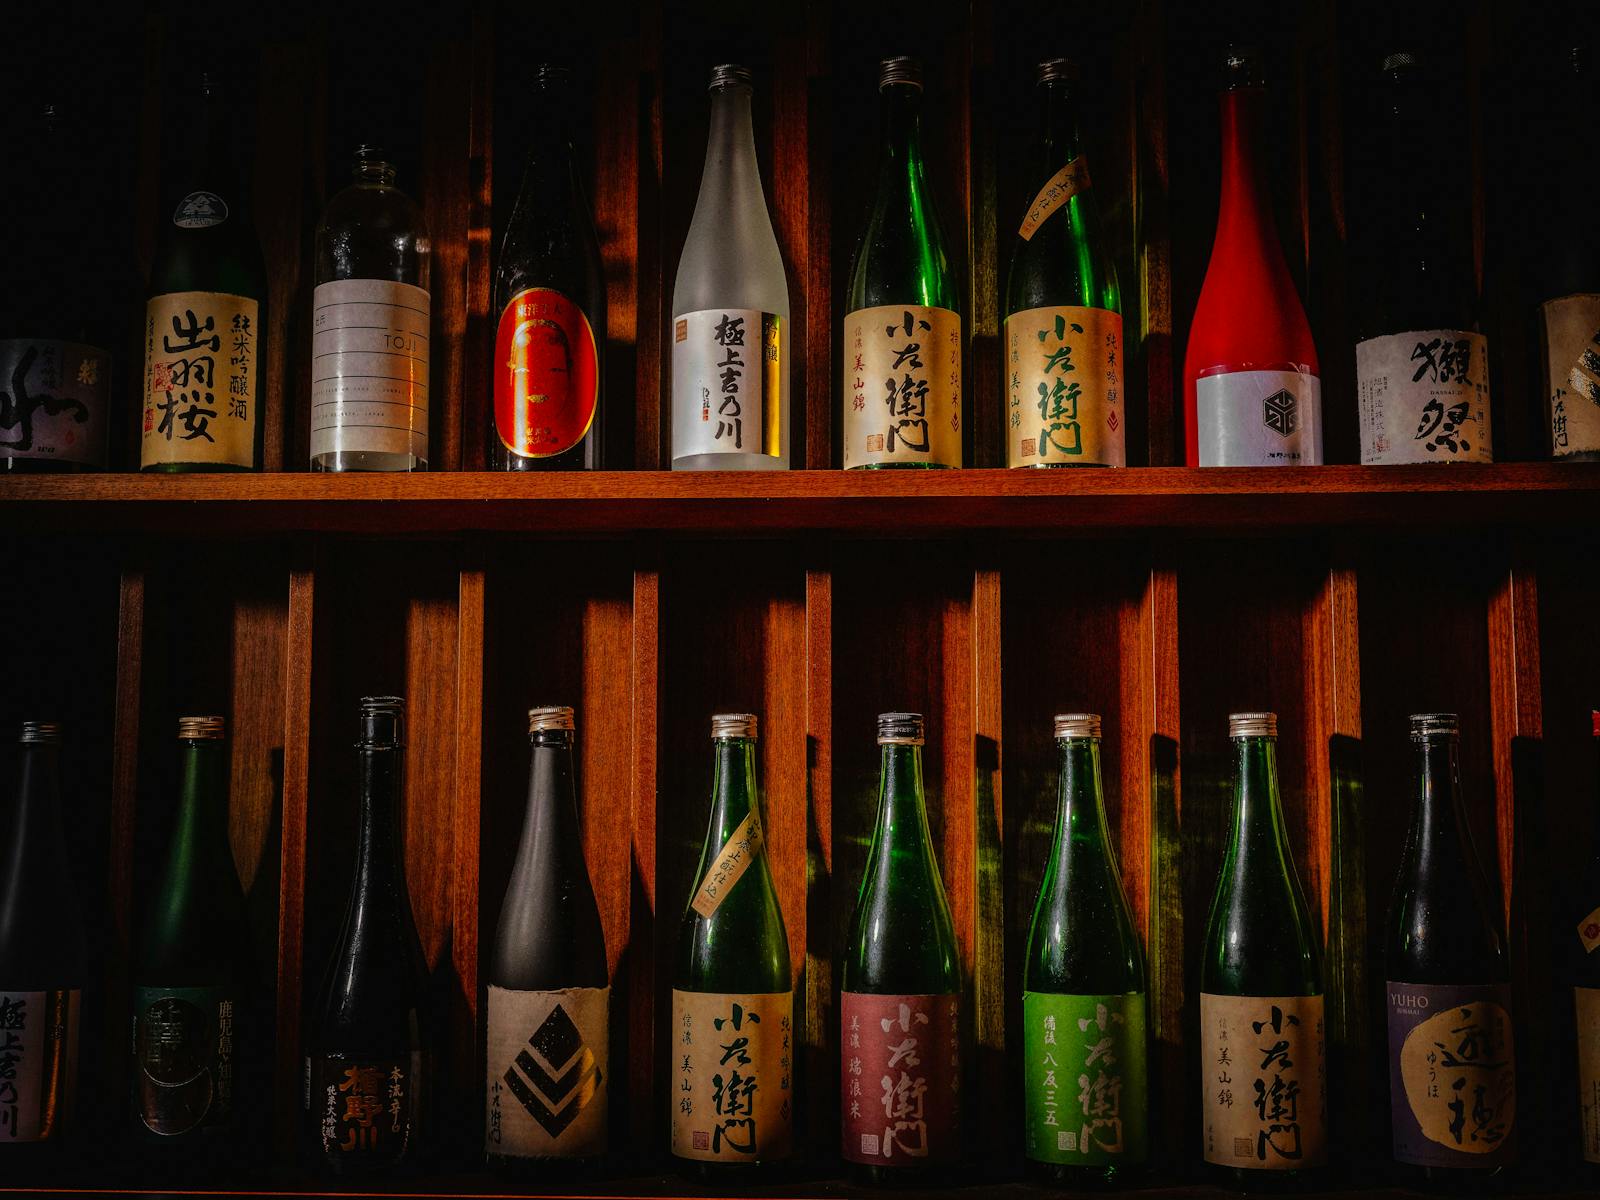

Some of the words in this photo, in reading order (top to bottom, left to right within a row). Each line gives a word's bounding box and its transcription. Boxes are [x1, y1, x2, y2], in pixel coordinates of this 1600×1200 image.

[157, 309, 221, 443] 出羽桜
[714, 314, 745, 449] 極上吉乃川
[853, 354, 865, 412] 美山錦
[1411, 338, 1477, 453] 獺祭
[1391, 993, 1429, 1009] YUHO
[680, 1055, 693, 1117] 美山錦
[849, 1057, 862, 1119] 瑞浪米
[1043, 1052, 1059, 1126] 八反三五
[1217, 1048, 1234, 1109] 美山錦
[1427, 1051, 1440, 1098] ゆうほ
